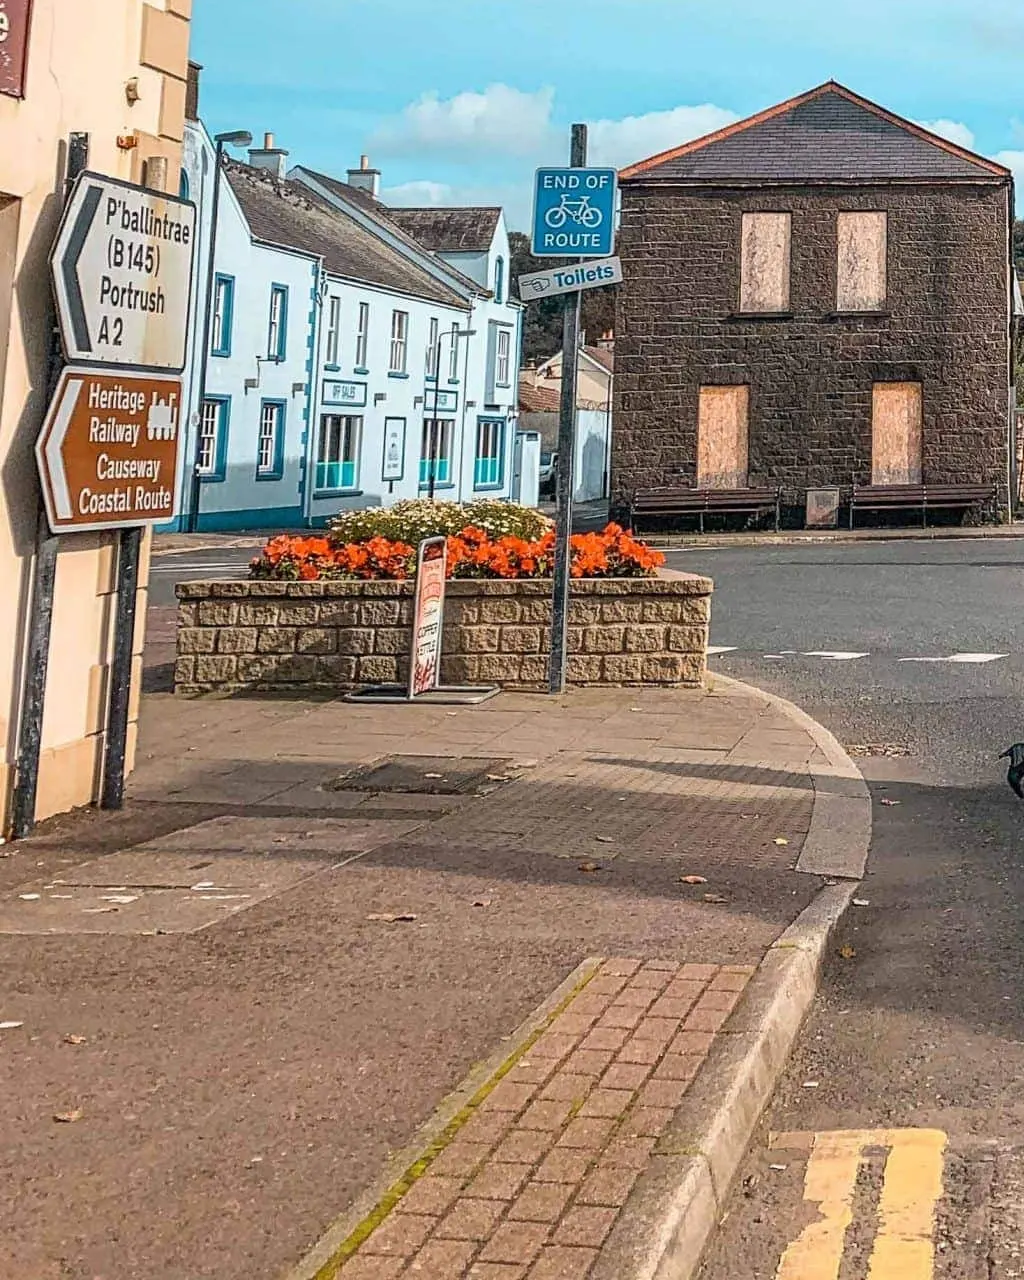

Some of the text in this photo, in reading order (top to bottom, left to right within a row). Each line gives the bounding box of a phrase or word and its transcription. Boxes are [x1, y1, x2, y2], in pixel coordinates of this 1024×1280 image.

[543, 175, 609, 189] END OF
[105, 197, 190, 245] P'ballintrae
[544, 233, 601, 247] ROUTE
[553, 264, 614, 287] Toilets
[100, 275, 165, 314] Portrush
[88, 382, 145, 415] Heritage
[88, 416, 141, 448] Railway
[97, 453, 161, 483] Causeway
[78, 485, 172, 515] Coastal Route
